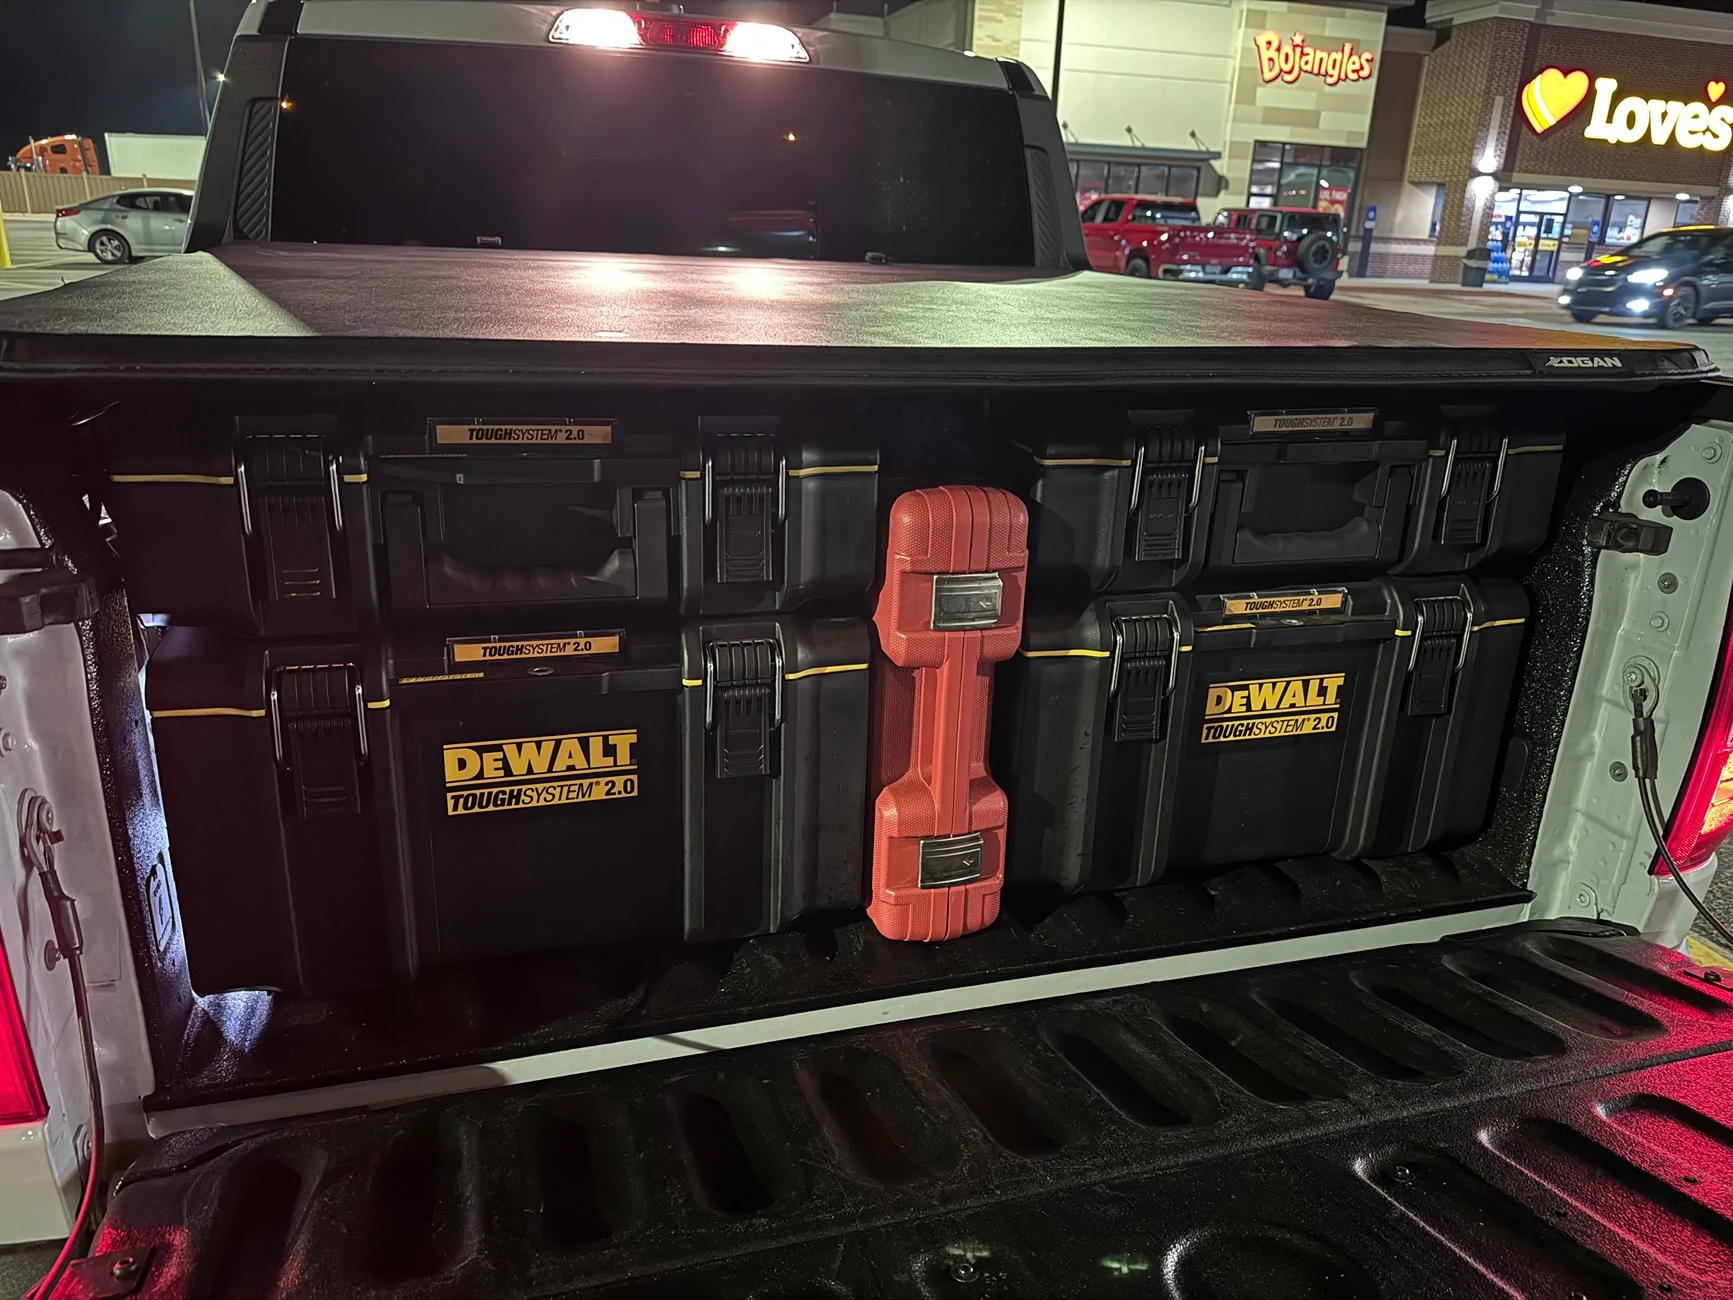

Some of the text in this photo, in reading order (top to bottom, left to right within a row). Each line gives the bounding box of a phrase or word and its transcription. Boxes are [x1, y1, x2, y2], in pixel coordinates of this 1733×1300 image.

[1253, 30, 1374, 86] Bojangles
[1339, 416, 1353, 427] 2.0
[467, 427, 585, 441] TOUGHSYSTEM 2.0
[1308, 597, 1322, 607] 2.0
[481, 640, 592, 657] TOUGHSYSTEM 2.0
[1204, 715, 1335, 741] TOUGHSYSTEM 2.0
[450, 778, 635, 812] TOUGHSYSTEM 2.0
